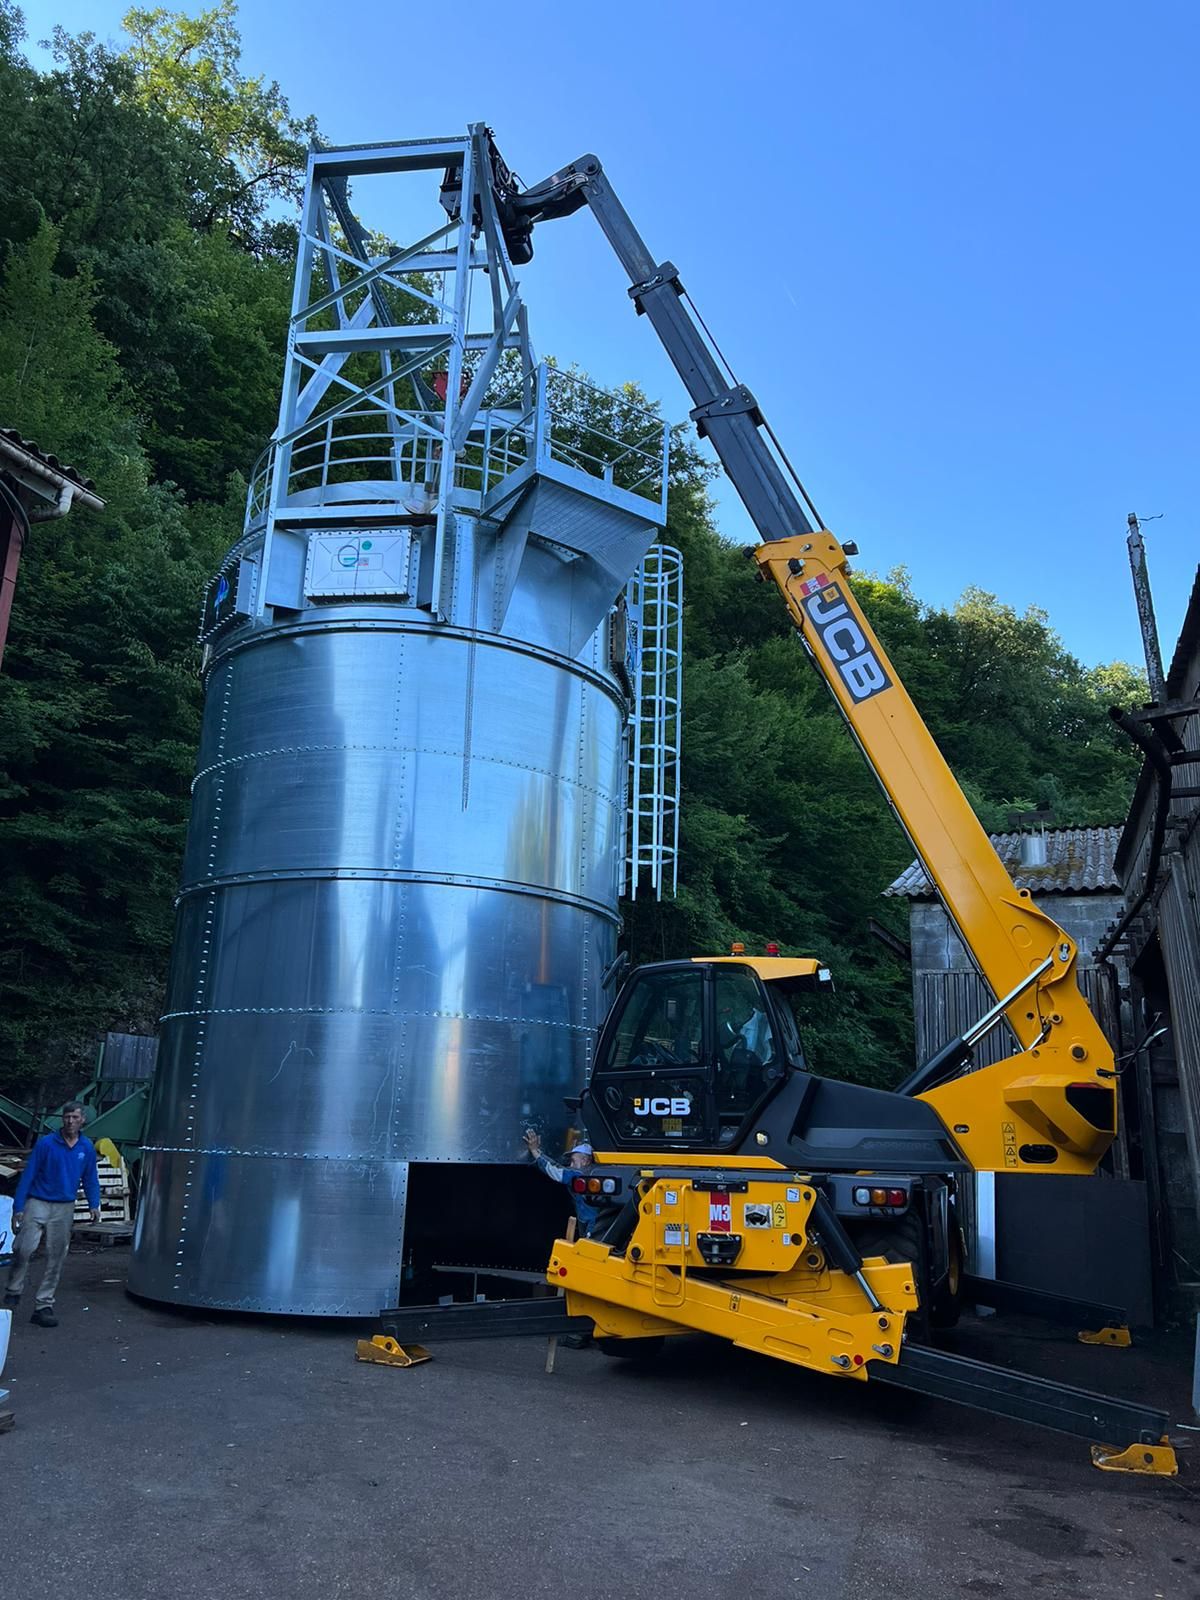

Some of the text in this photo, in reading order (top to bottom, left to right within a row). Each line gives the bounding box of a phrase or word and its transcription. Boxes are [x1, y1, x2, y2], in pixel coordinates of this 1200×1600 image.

[807, 594, 886, 698] JCB
[634, 1097, 691, 1116] JCB
[709, 1203, 731, 1222] M3
